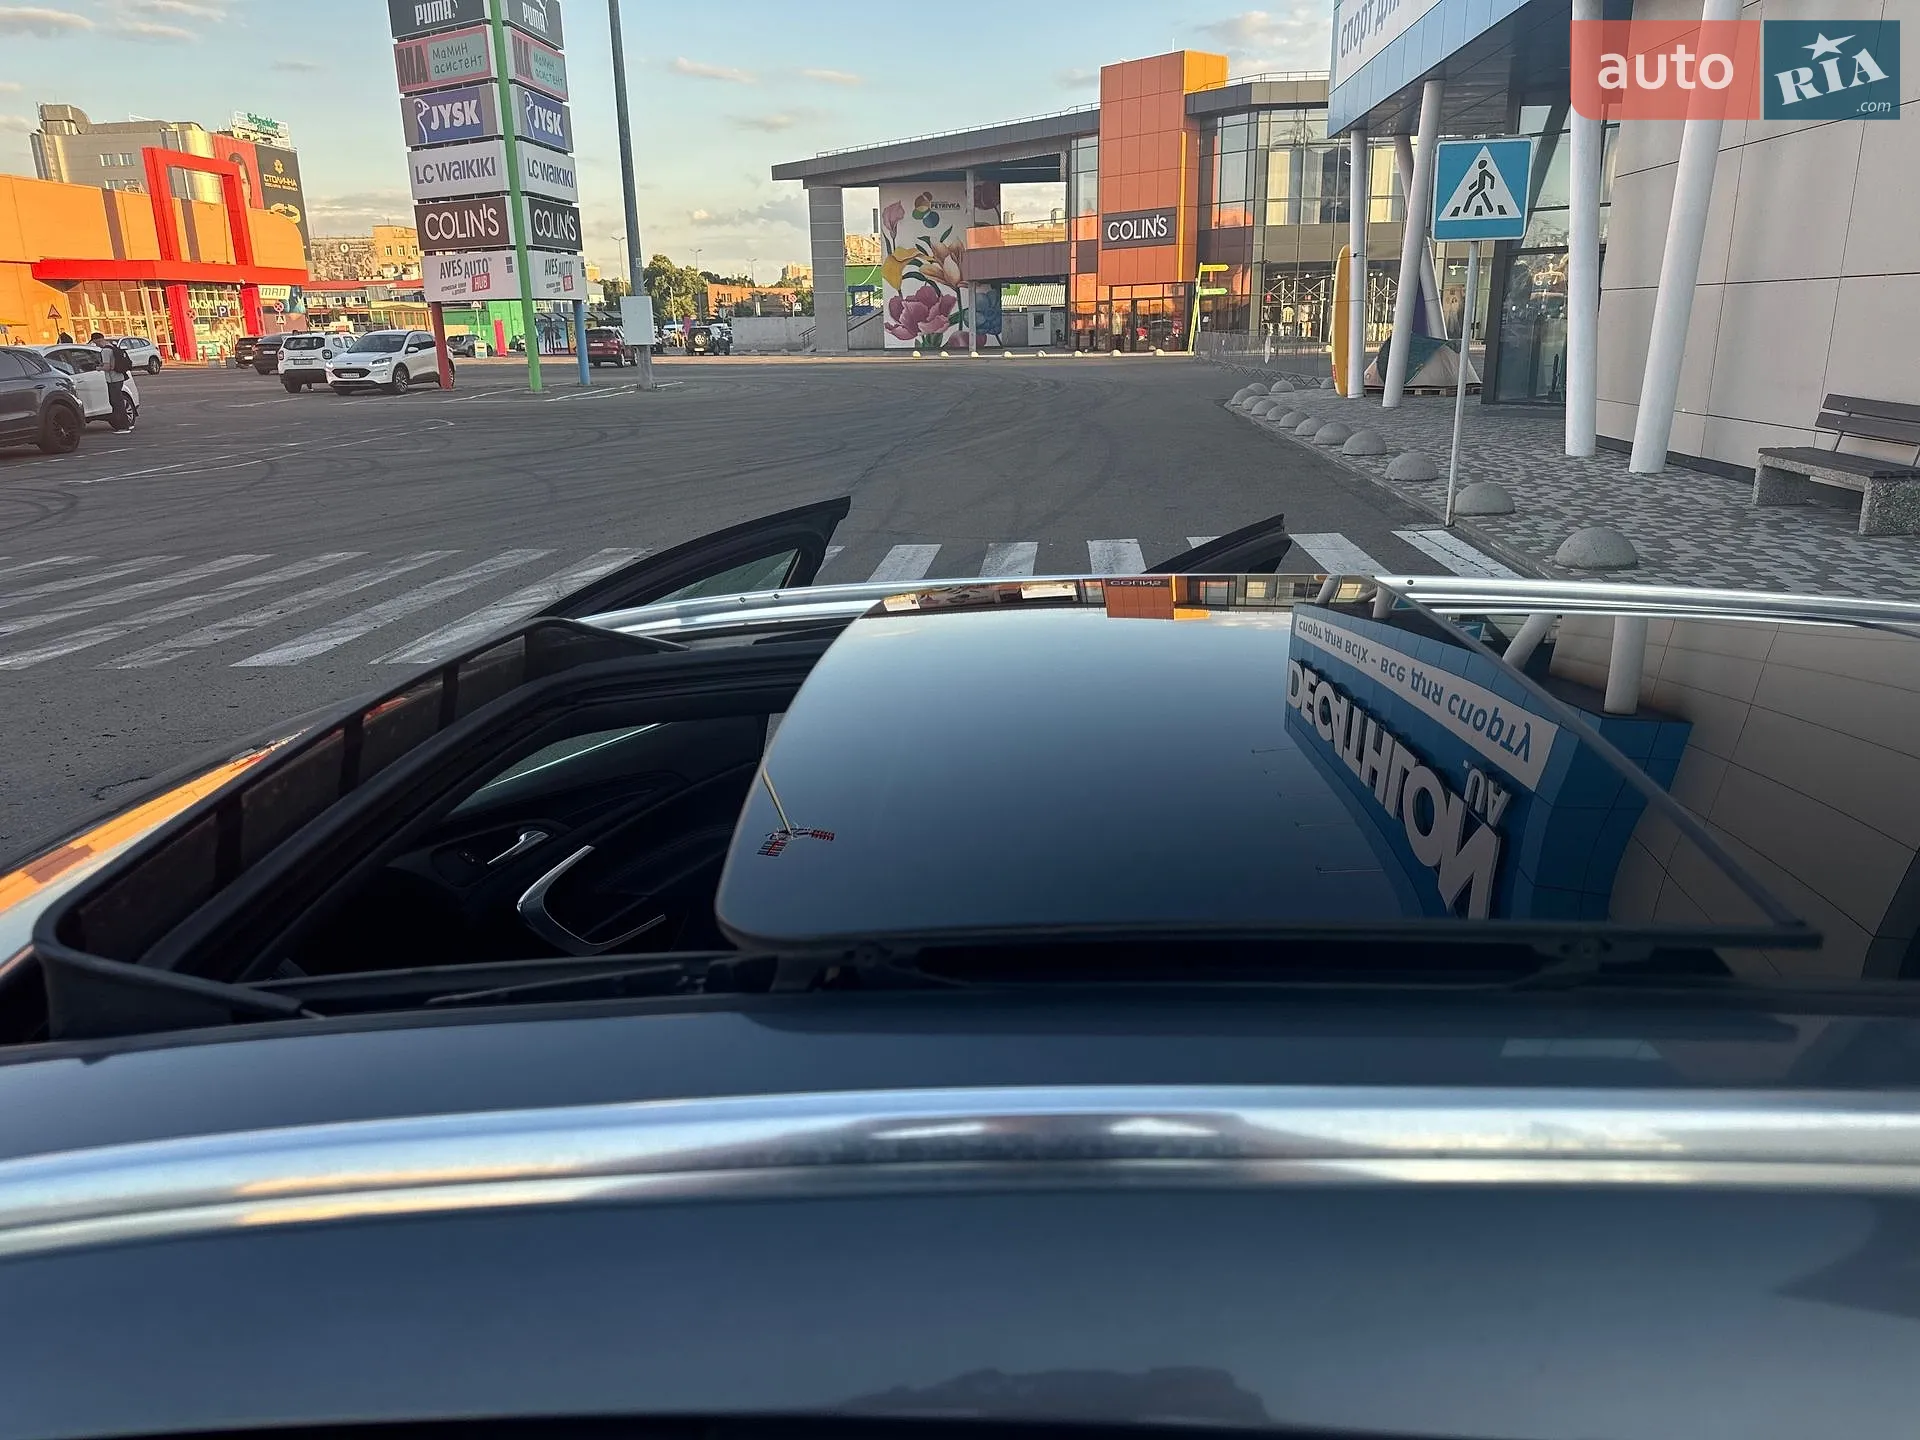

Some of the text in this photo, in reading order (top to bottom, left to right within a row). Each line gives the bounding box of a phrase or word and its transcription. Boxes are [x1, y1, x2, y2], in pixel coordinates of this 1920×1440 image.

[414, 0, 452, 26] PUMA
[522, 3, 547, 33] PUMA
[1341, 0, 1373, 58] спорт
[434, 55, 483, 74] асистент
[430, 99, 481, 131] JYSK
[533, 105, 563, 137] JYSK
[415, 164, 433, 185] LC
[527, 157, 539, 179] LC
[424, 203, 500, 241] COLIN'S
[534, 208, 577, 242] COLIN'S
[1107, 214, 1168, 241] COLIN'S
[440, 258, 489, 279] AVES AUTO
[544, 258, 558, 277] AVES
